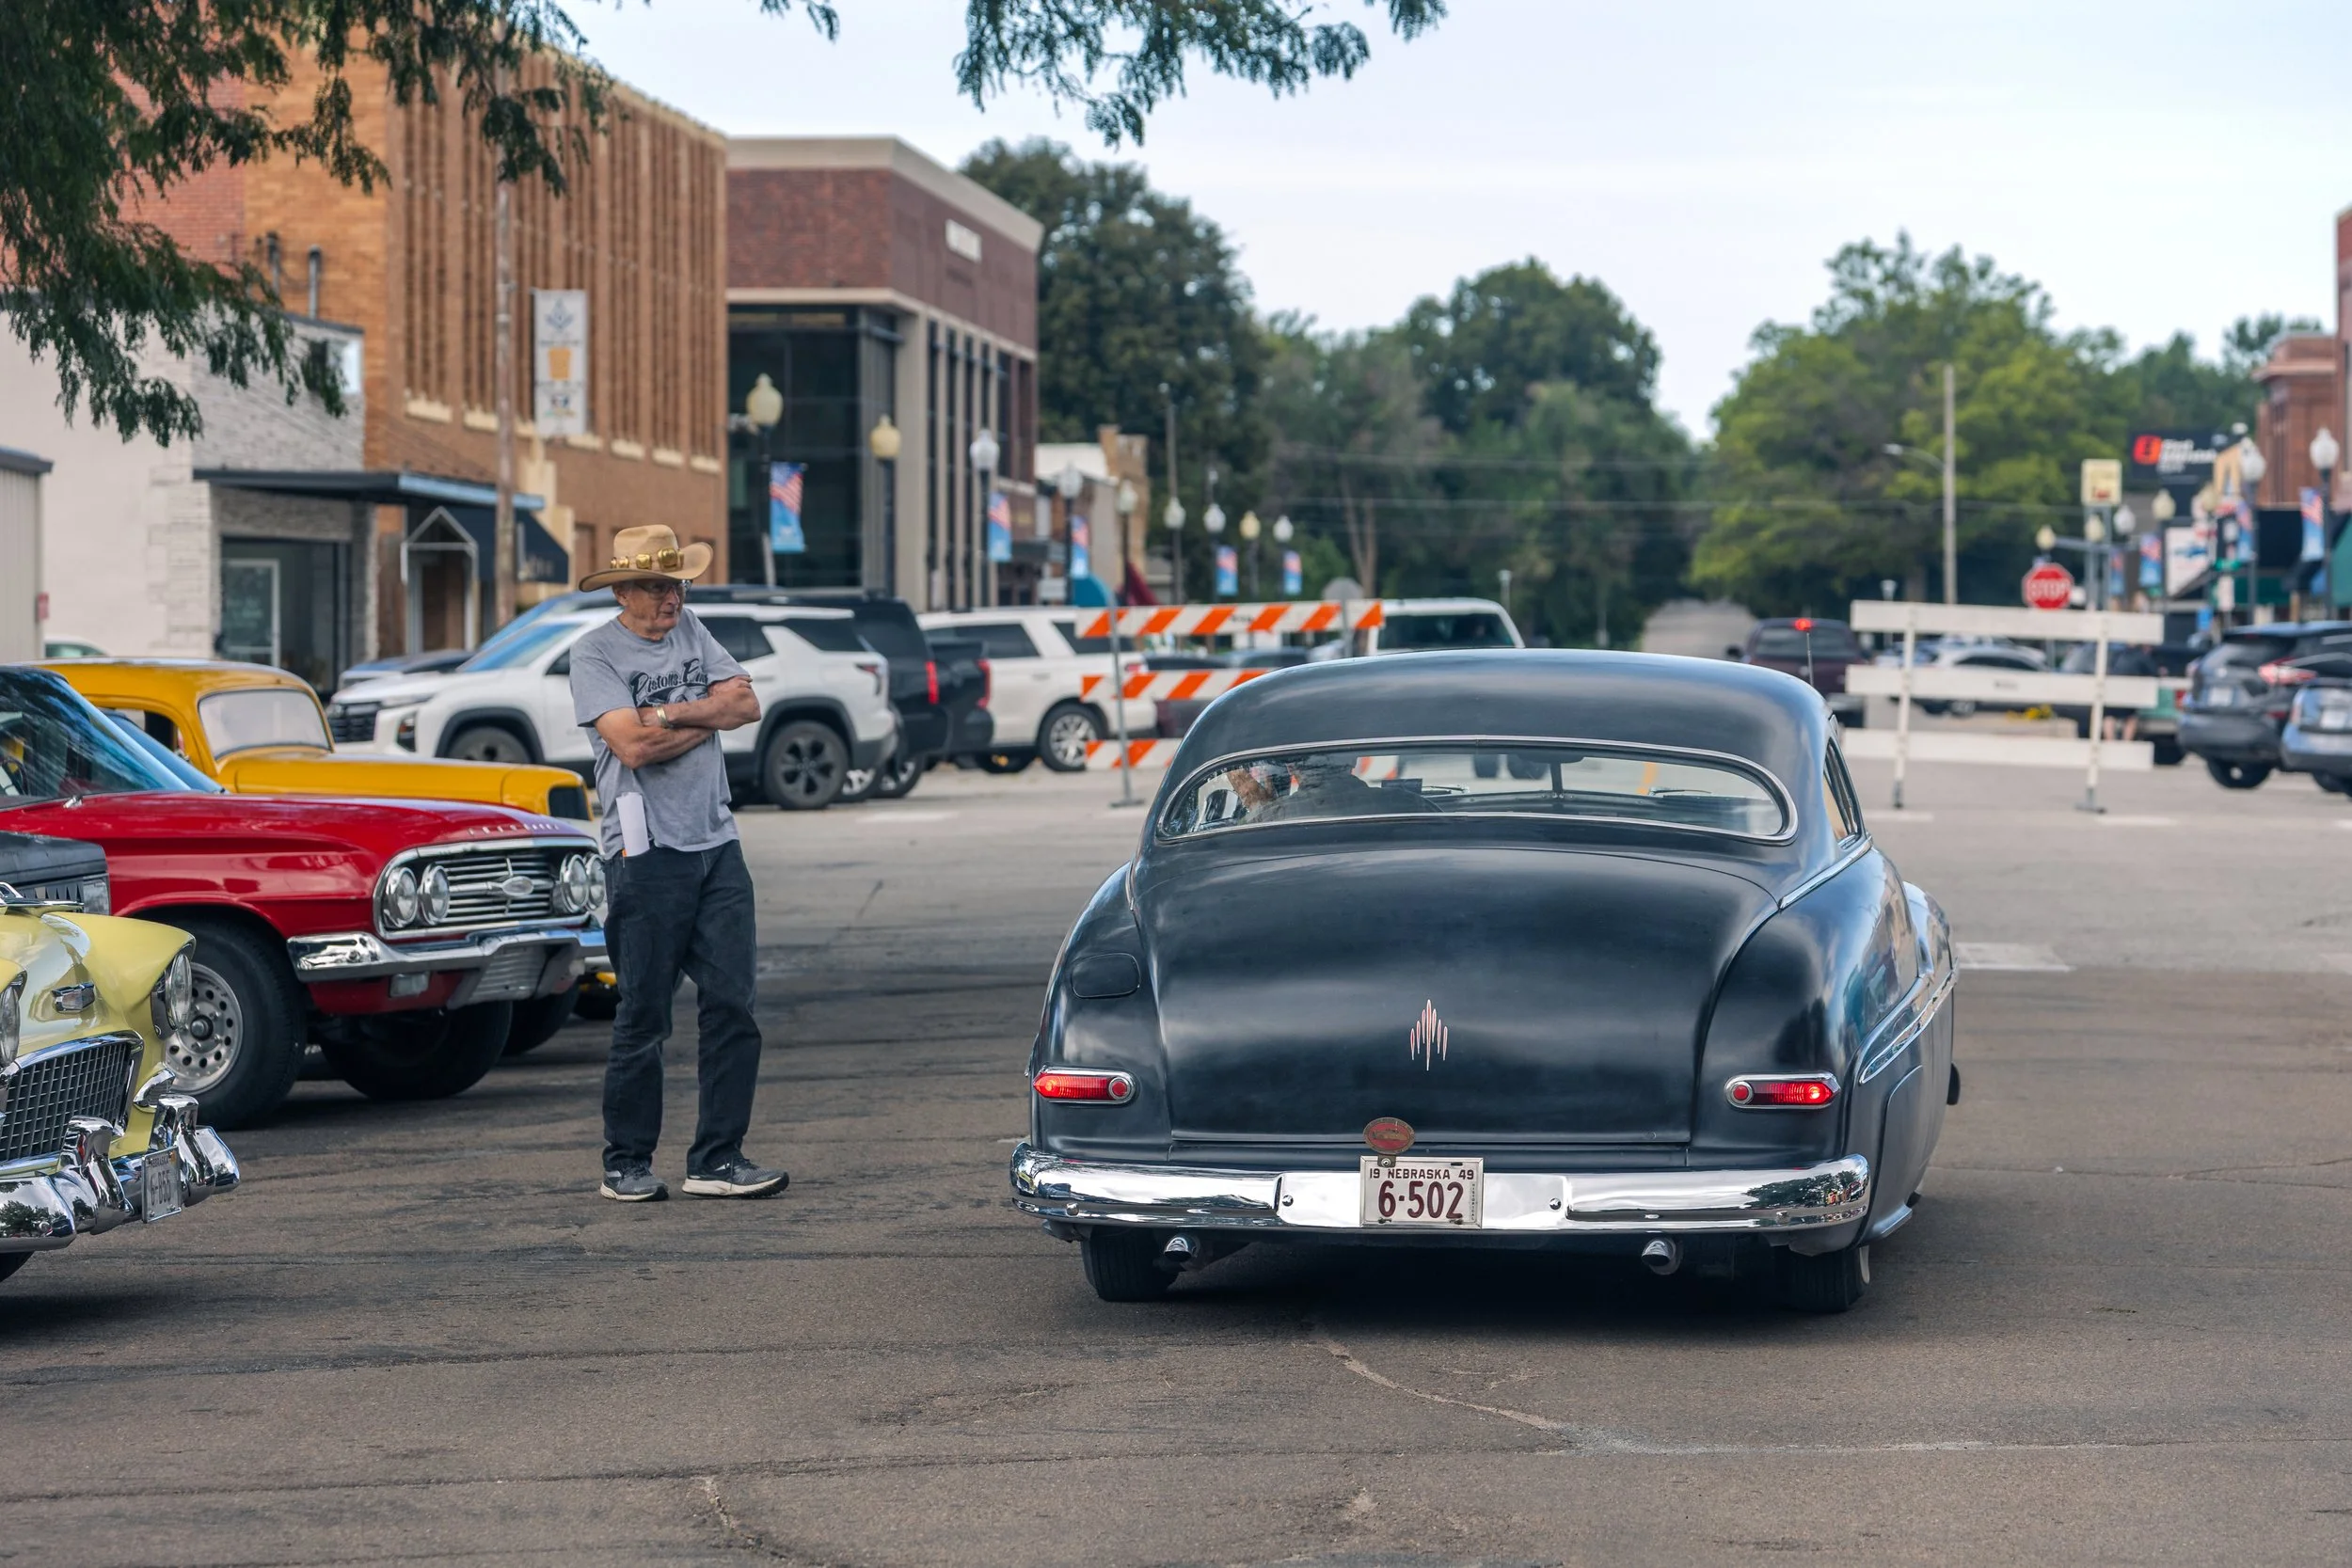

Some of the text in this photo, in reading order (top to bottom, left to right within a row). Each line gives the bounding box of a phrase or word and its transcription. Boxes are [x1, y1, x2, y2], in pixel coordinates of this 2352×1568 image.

[2026, 577, 2071, 600] STOP
[1370, 1168, 1474, 1180] 19 NEBRASKA 49
